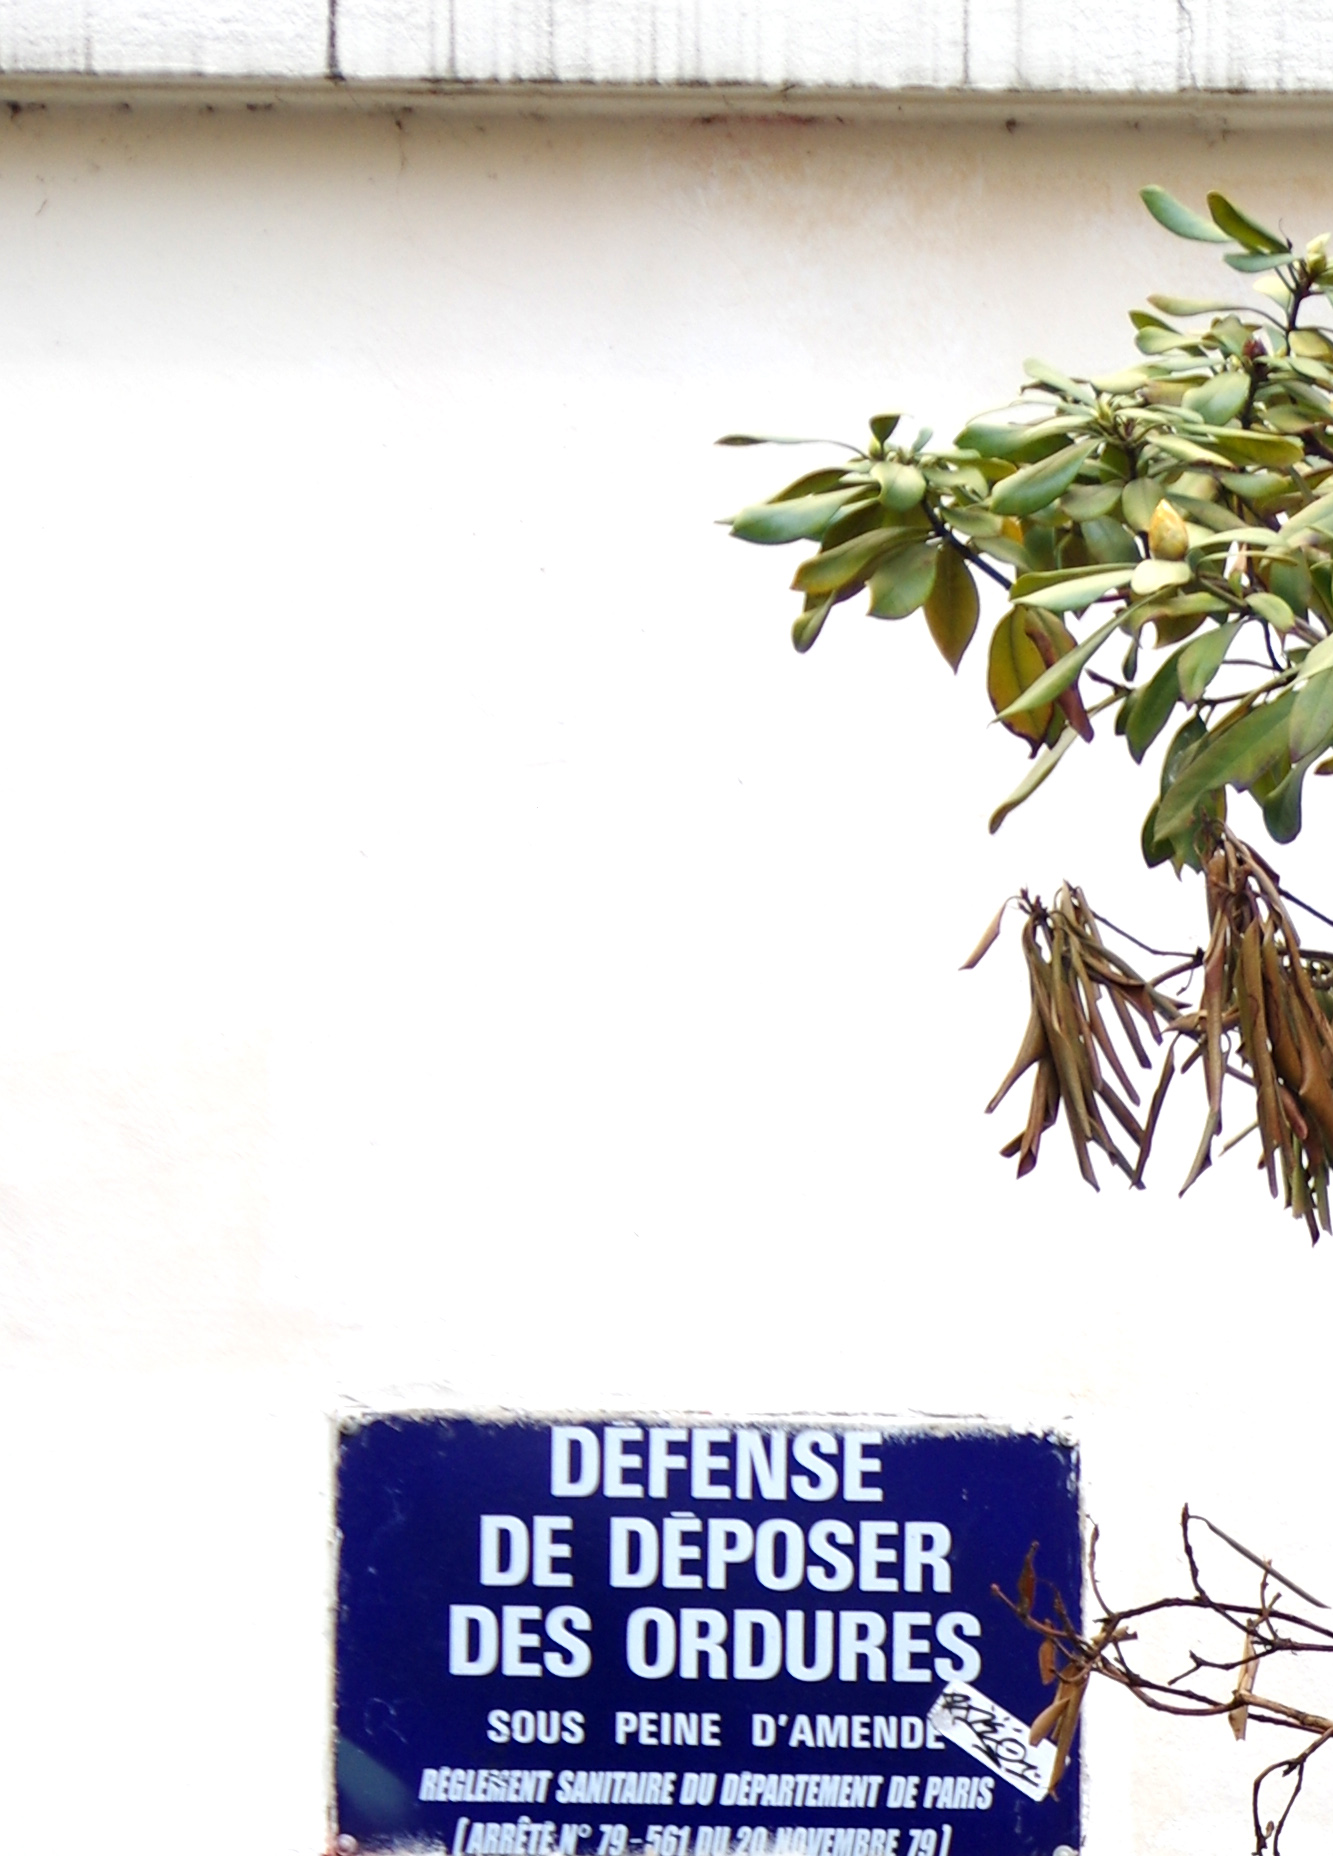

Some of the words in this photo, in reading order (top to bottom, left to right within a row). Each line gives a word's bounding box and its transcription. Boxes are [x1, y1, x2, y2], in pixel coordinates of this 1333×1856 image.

[479, 1514, 573, 1588] DE
[609, 1511, 952, 1593] DÉPOSER
[449, 1604, 592, 1678] DES
[626, 1606, 982, 1683] ORDURES
[487, 1709, 586, 1744] SOUS
[614, 1711, 722, 1747] PEINE
[555, 1769, 677, 1805] SANITAIRE
[679, 1772, 717, 1806] DU
[887, 1774, 920, 1808] DE
[923, 1776, 995, 1810] PARIS
[735, 1826, 770, 1856] 20
